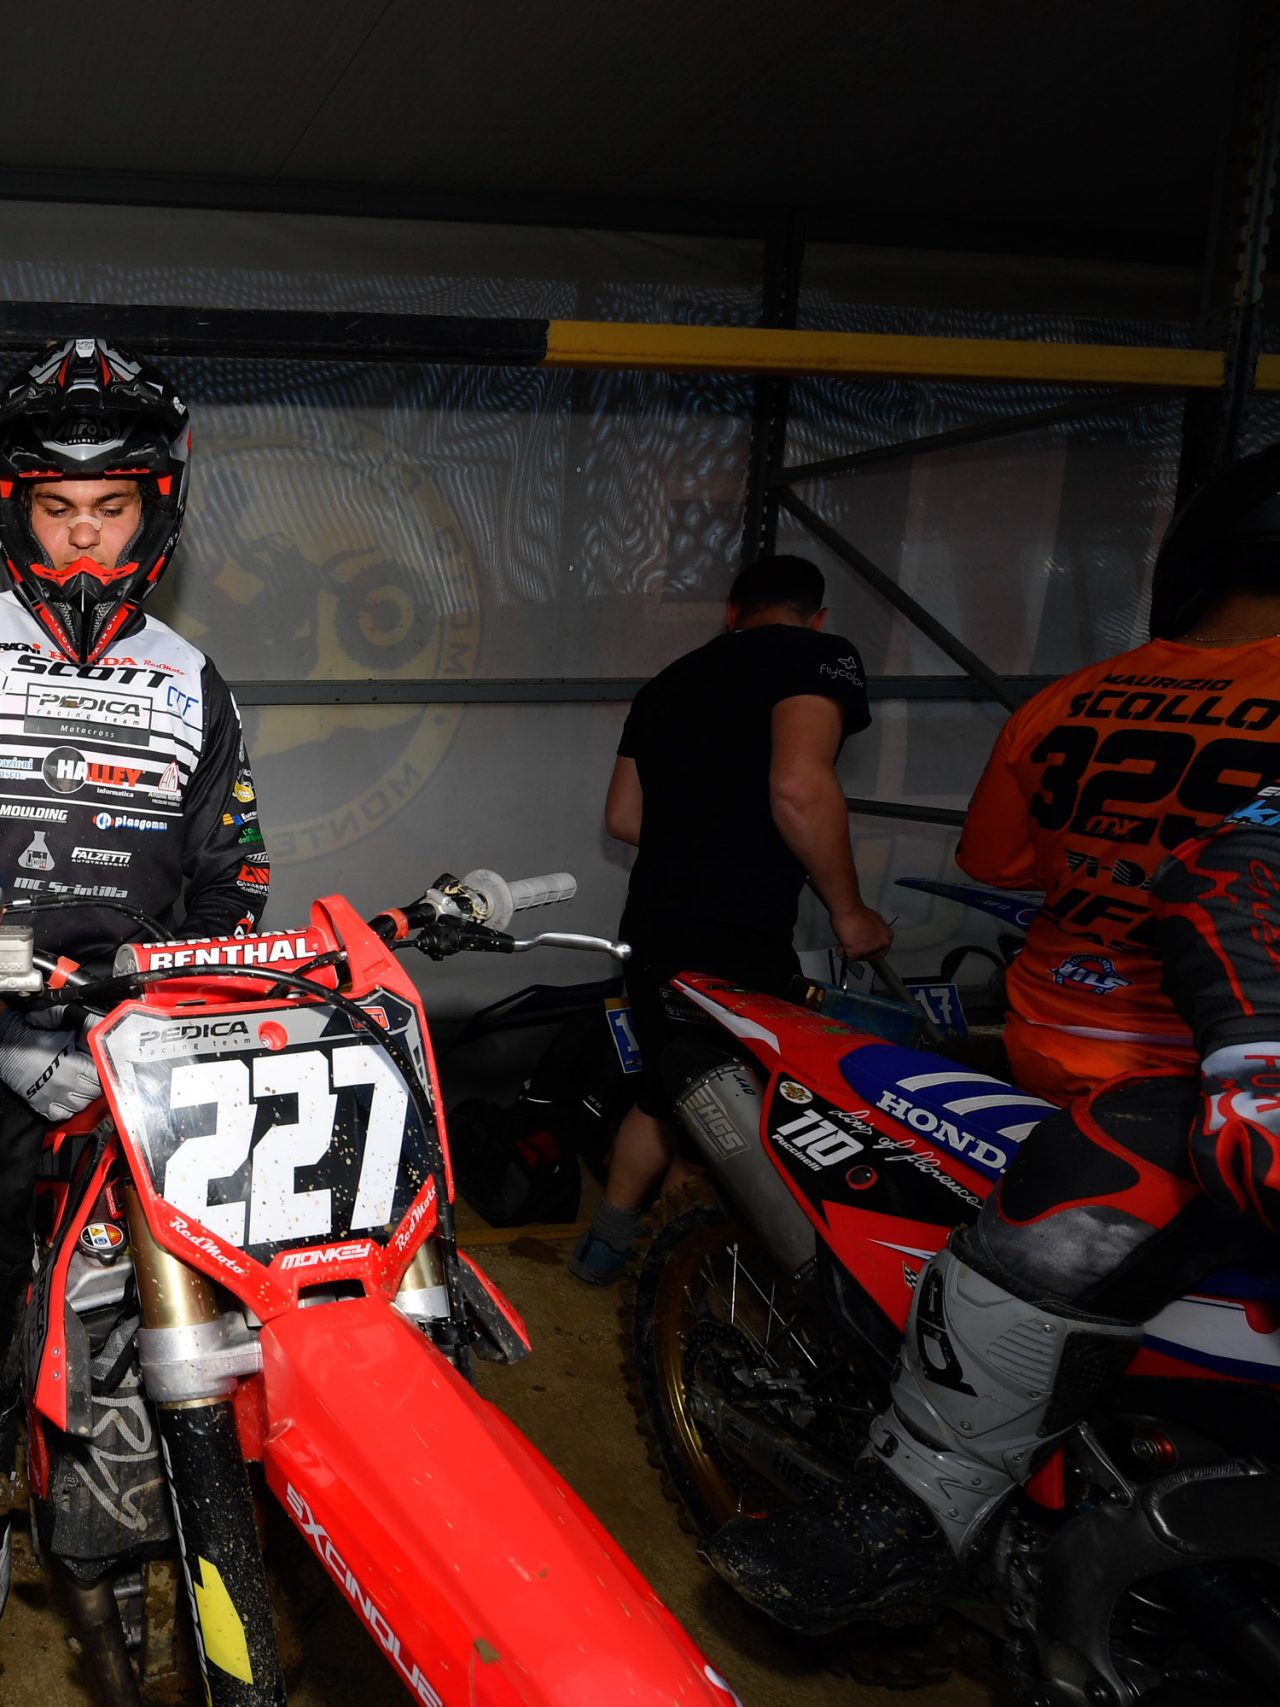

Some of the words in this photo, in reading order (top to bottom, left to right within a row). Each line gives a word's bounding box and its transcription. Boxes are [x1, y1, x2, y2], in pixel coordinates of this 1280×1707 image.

[11, 654, 174, 689] SCOTT
[1098, 673, 1234, 691] MAURIZIO
[36, 708, 93, 721] racing
[104, 715, 140, 726] team
[39, 693, 141, 717] PEDICA
[1067, 689, 1280, 731] SCOLLO
[60, 724, 116, 738] Motocross
[57, 759, 143, 788] HALLEY
[0, 804, 68, 822] MOULDING
[71, 846, 133, 863] FALZETTI
[150, 937, 317, 971] RENTHAL
[139, 1020, 250, 1047] PEDICA
[163, 1044, 410, 1247] 227
[776, 1108, 864, 1167] 110
[876, 1089, 1008, 1174] HOND
[771, 1134, 824, 1172] Puccinelli
[280, 1242, 371, 1270] MONKEY
